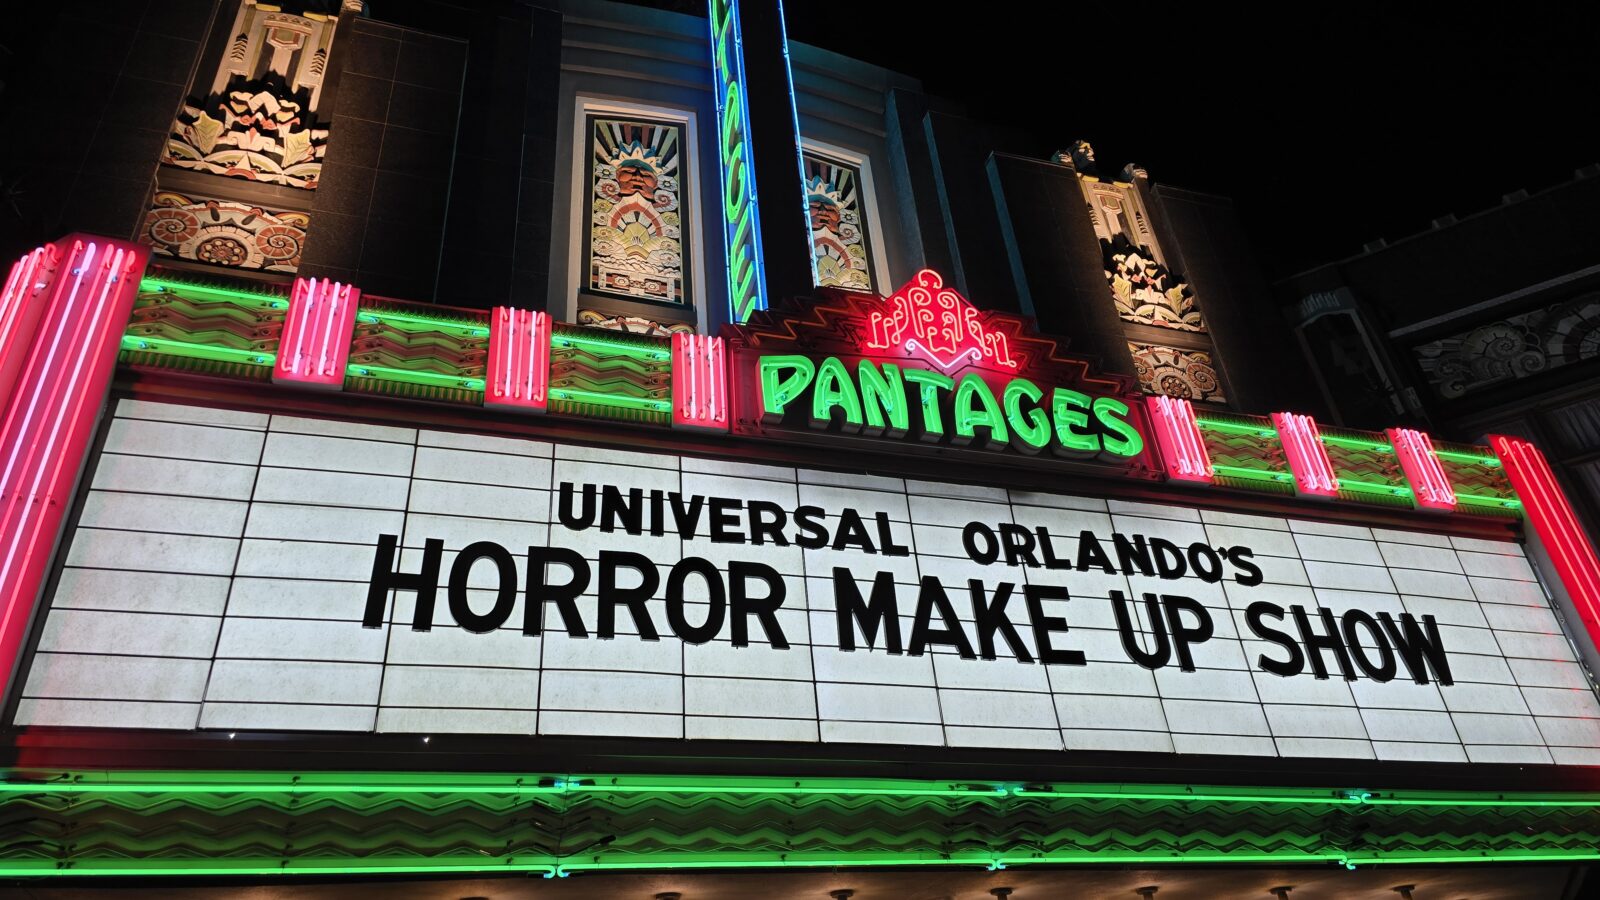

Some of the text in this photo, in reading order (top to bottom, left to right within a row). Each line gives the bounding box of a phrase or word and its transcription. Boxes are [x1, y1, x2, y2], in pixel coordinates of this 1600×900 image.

[759, 355, 1143, 458] PANTAGES
[558, 481, 1264, 587] UNIVERSAL ORLANDO'S
[362, 534, 1454, 686] HORROR MAKE UP SHOW
